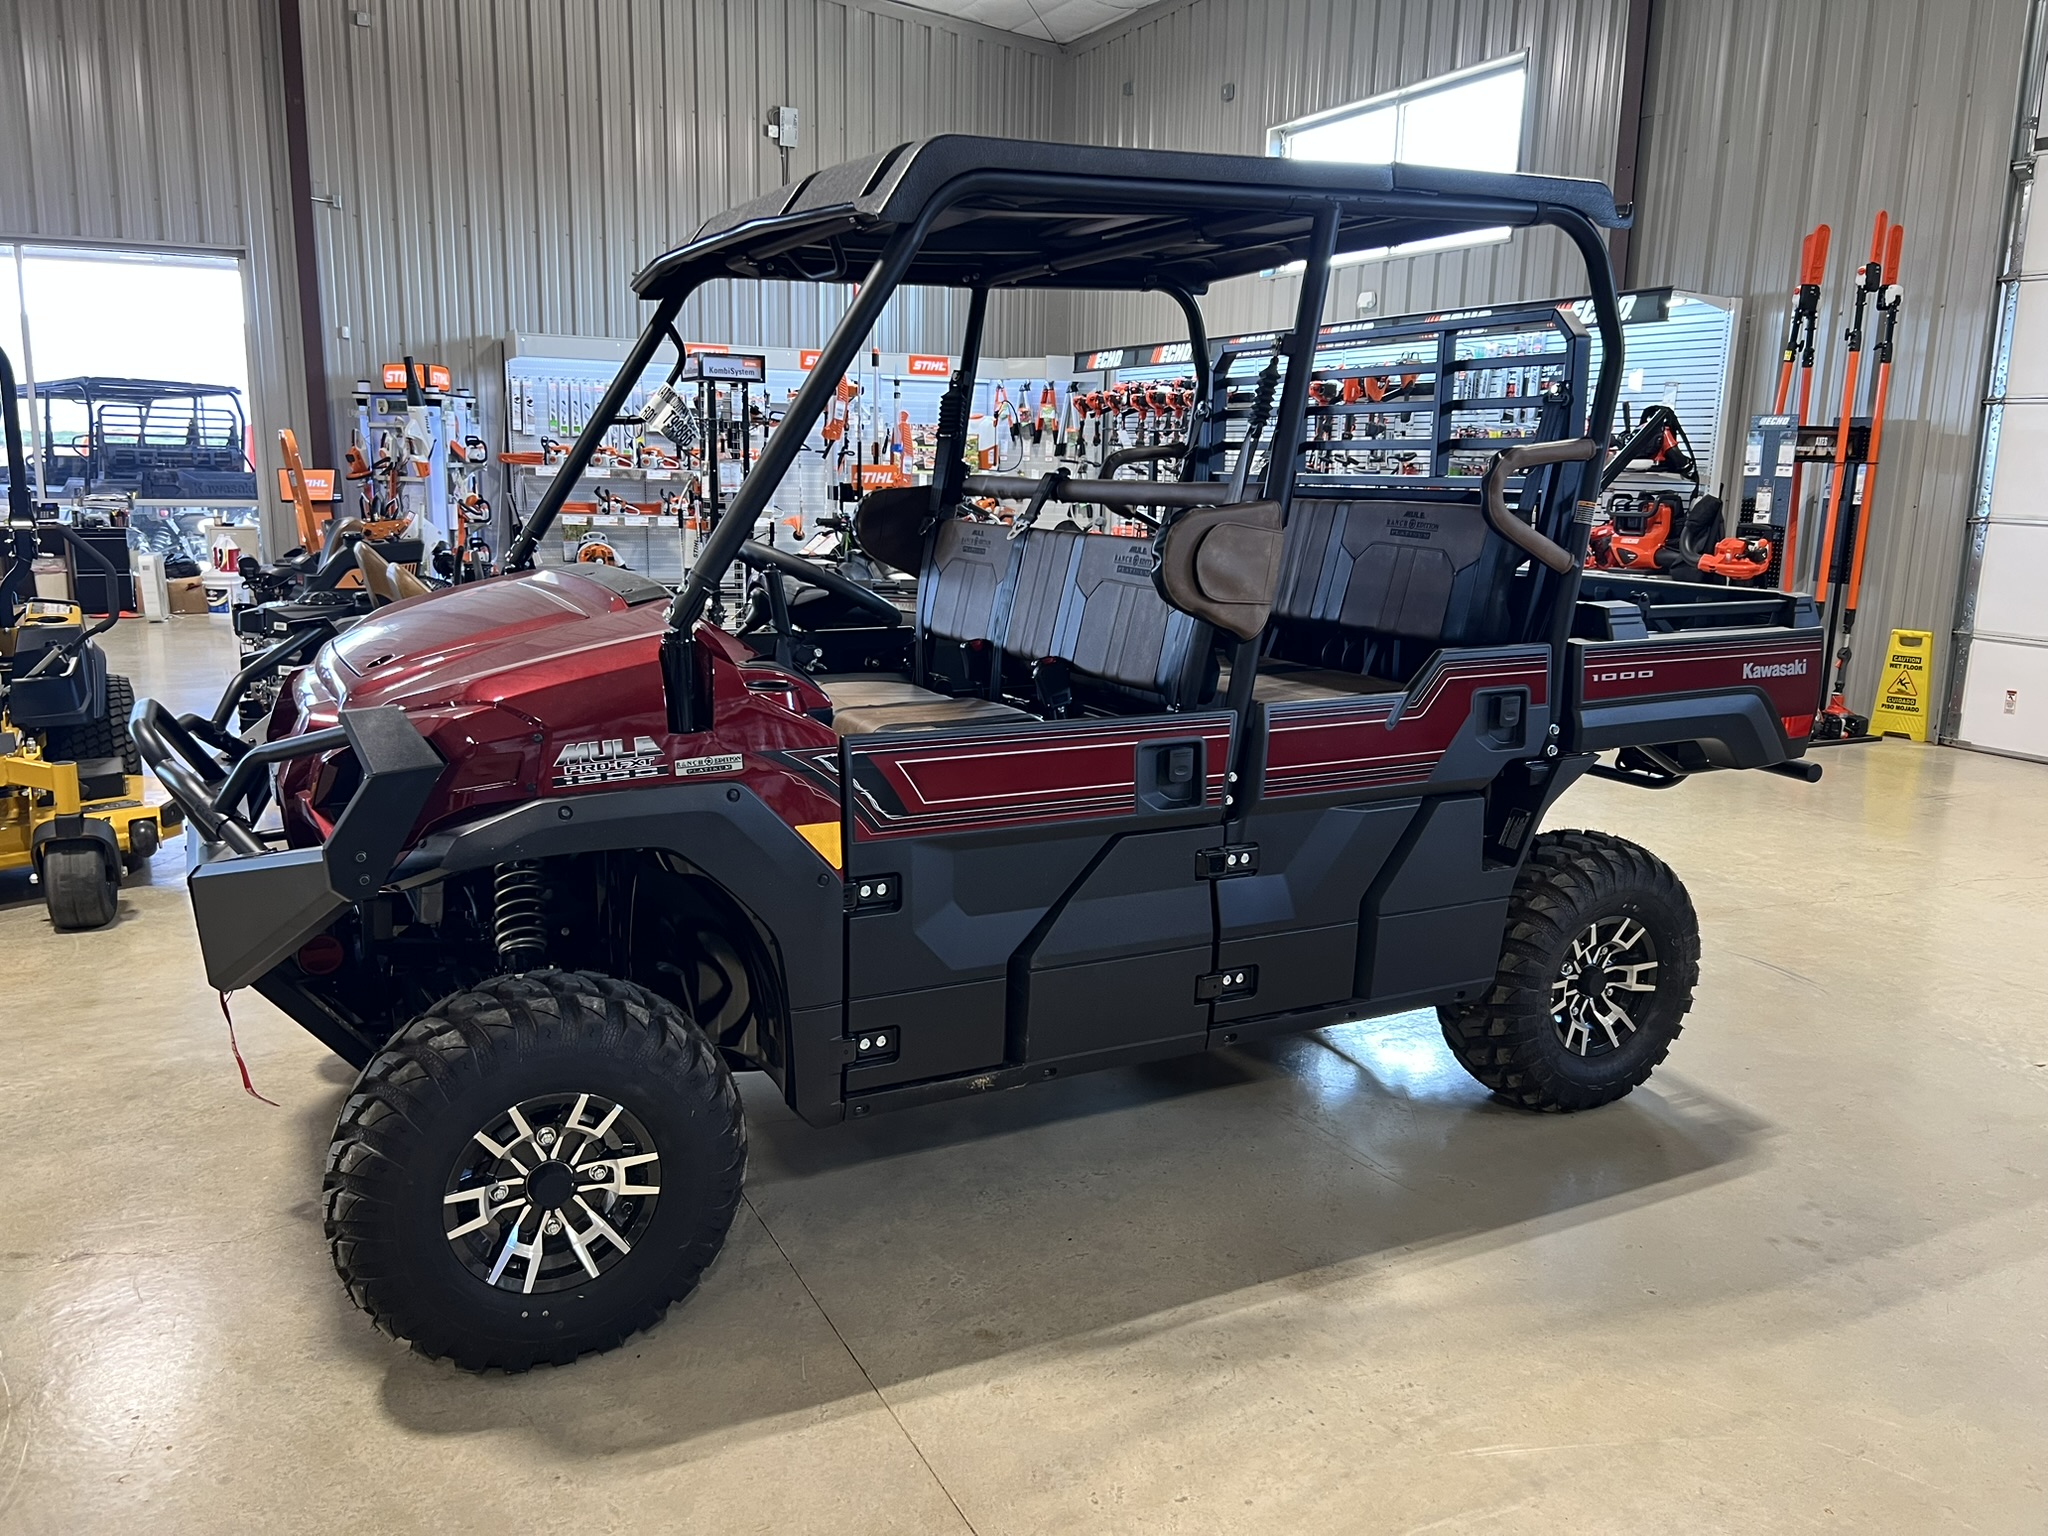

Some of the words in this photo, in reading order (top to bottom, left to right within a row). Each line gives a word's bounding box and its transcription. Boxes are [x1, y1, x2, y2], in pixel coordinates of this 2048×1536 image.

[1572, 295, 1637, 324] ECO
[1095, 350, 1124, 368] ECHO
[1162, 343, 1193, 363] ECHO
[709, 366, 755, 376] KombiSystem
[912, 360, 946, 370] STIHL
[385, 370, 407, 383] STI
[1766, 417, 1790, 425] ECHO
[663, 410, 696, 446] T90866
[304, 479, 329, 487] TIHL
[1893, 655, 1921, 664] CAUTION
[1742, 659, 1807, 679] Kawasaki
[1592, 670, 1653, 682] 1000
[1887, 696, 1916, 705] CUIDADO
[552, 736, 666, 768] MULE
[676, 760, 705, 769] RANCH
[714, 756, 741, 764] EDITION
[687, 765, 732, 774] PLATINUM
